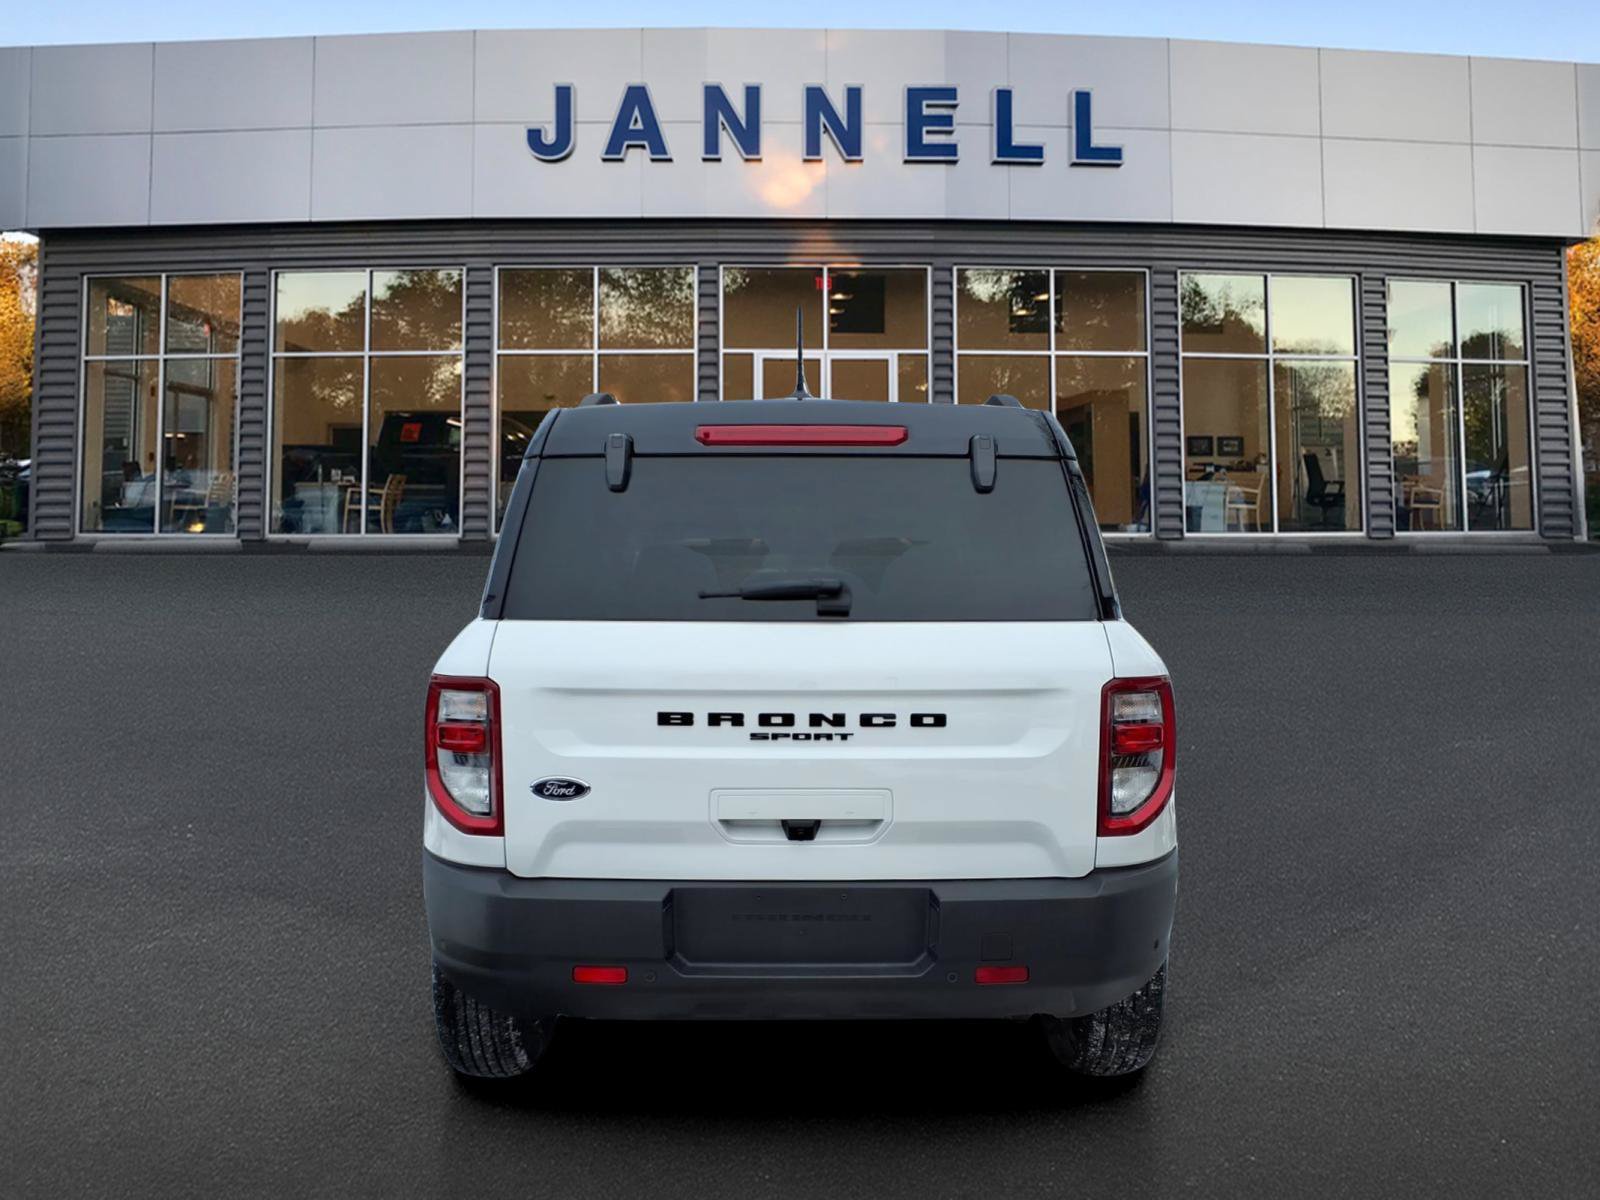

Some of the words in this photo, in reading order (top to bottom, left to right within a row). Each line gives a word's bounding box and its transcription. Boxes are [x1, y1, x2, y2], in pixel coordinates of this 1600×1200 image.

[525, 82, 1124, 164] JANNELL
[656, 711, 948, 728] BRONCO
[749, 732, 854, 741] SPORT
[543, 781, 576, 796] Ford
